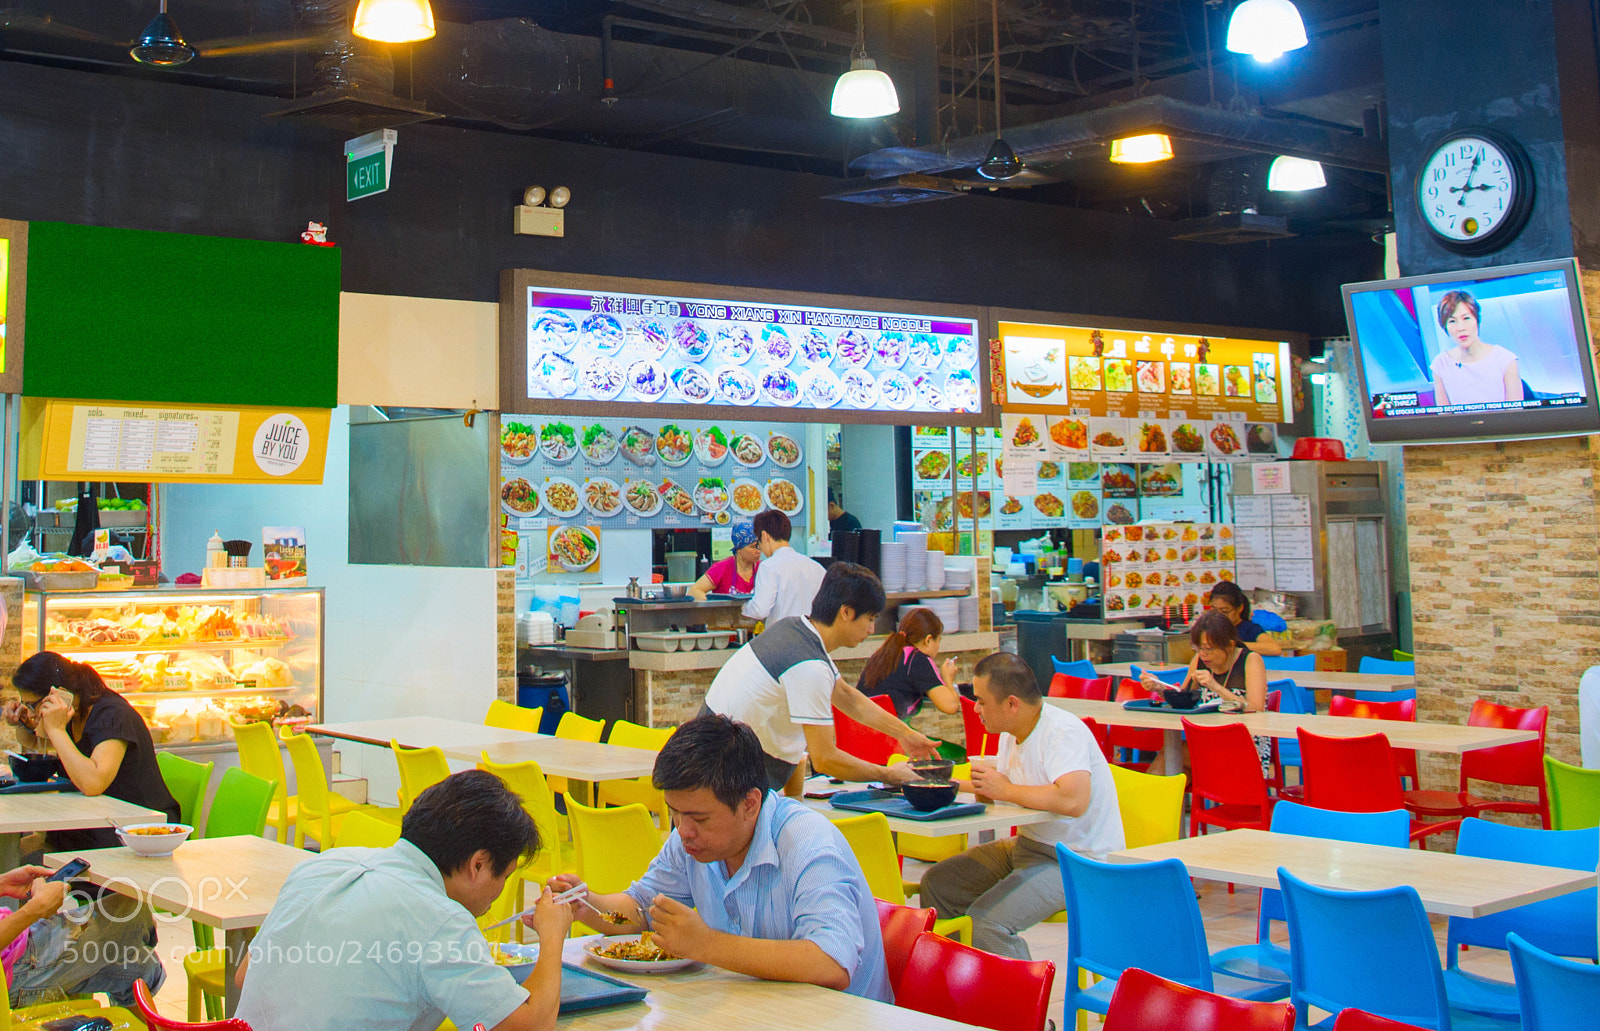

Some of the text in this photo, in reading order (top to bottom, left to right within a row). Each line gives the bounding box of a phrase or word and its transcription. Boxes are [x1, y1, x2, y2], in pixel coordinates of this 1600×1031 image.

[1460, 145, 1473, 159] 12
[1445, 152, 1455, 167] 11
[1492, 159, 1501, 173] 2
[359, 162, 380, 189] EXIT
[1434, 167, 1446, 181] 10
[1499, 177, 1508, 192] 3
[1428, 187, 1438, 200] 9
[1435, 204, 1444, 218] 8
[1449, 214, 1456, 229] 7
[1482, 212, 1492, 226] 5
[686, 304, 726, 318] YONG
[731, 307, 774, 321] XIANG
[777, 310, 802, 324] XIN
[805, 312, 879, 329] HANDMADE
[882, 318, 931, 332] NOODLE
[123, 409, 144, 418] mixed
[158, 411, 194, 421] signatures
[266, 423, 302, 445] JUICE
[262, 441, 298, 460] BY YOU
[165, 679, 186, 687] $1.00
